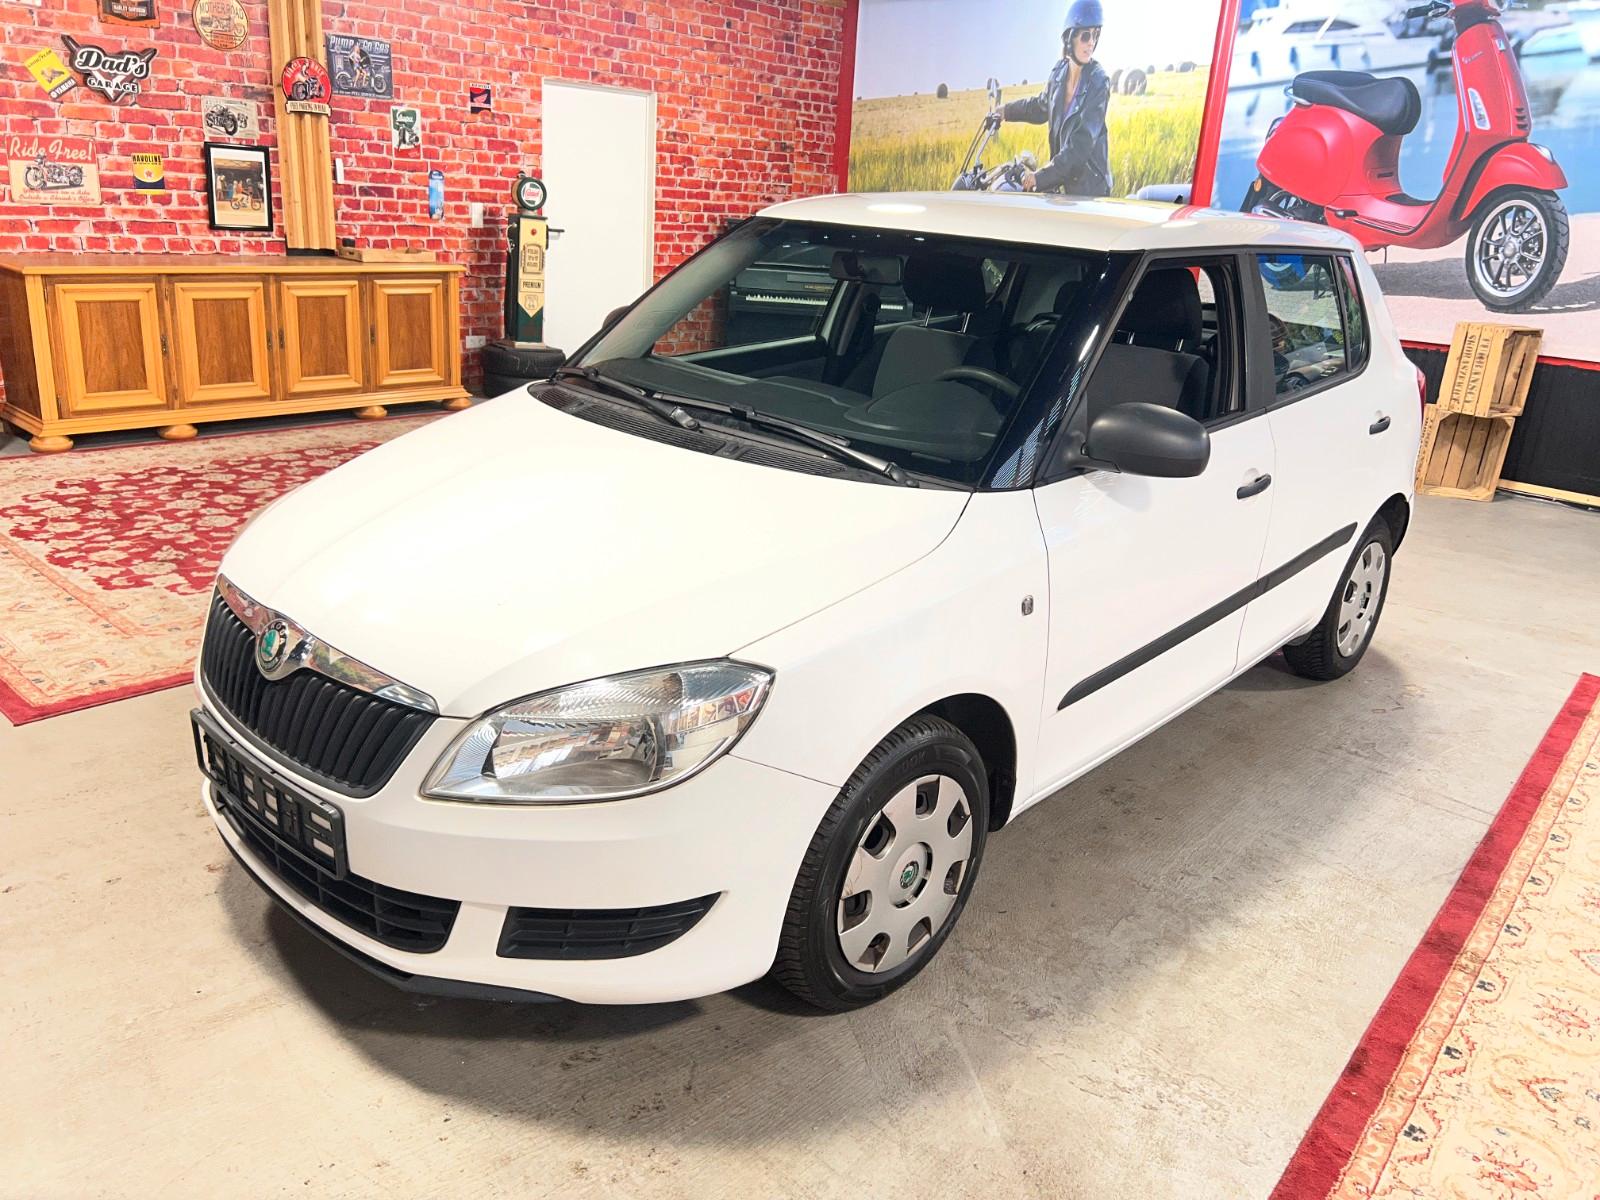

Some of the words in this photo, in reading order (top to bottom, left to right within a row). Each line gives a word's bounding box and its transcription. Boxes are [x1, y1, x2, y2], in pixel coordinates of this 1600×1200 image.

[76, 51, 147, 75] Dad's
[88, 78, 139, 92] GARAGE
[9, 136, 46, 158] Ride
[51, 138, 94, 161] Free!
[523, 281, 542, 289] PREMIUM
